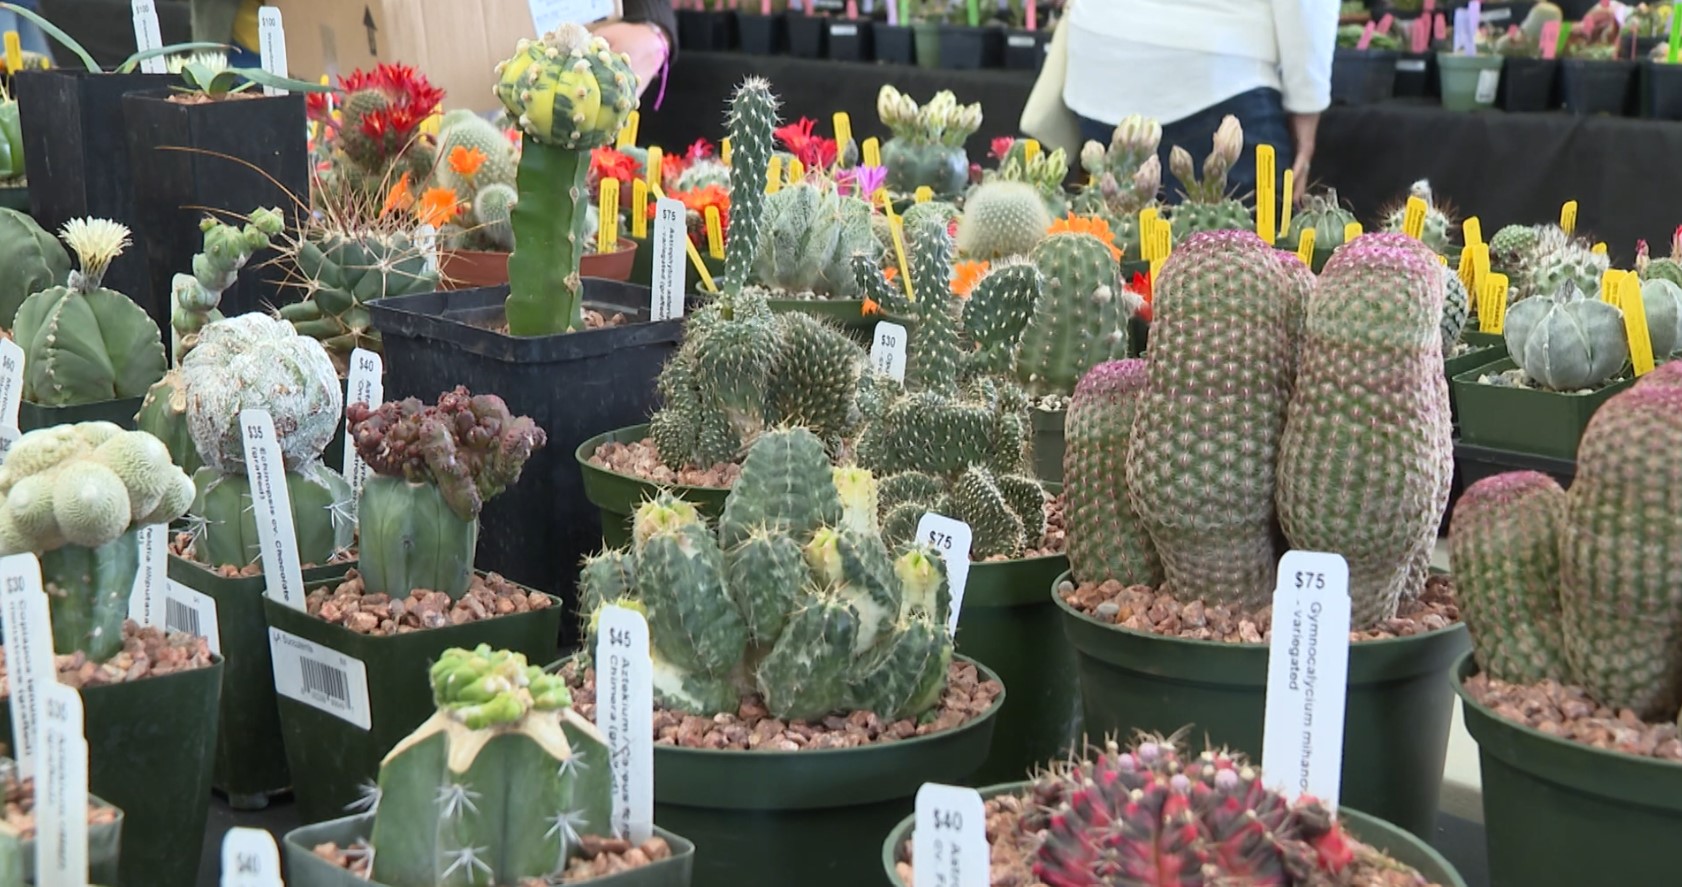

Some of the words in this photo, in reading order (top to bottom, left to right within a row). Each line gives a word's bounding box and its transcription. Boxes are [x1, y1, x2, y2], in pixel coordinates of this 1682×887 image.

[262, 18, 276, 27] $100
[662, 209, 676, 221] $75
[881, 334, 896, 348] $30
[359, 357, 374, 372] $40
[247, 425, 264, 439] $35
[251, 446, 266, 500] (grafted)
[259, 447, 276, 516] Echinopsis
[271, 518, 279, 538] cv.
[275, 540, 290, 602] Chocolate
[929, 530, 952, 550] $75
[6, 576, 25, 595] $30
[1294, 571, 1326, 590] $75
[609, 627, 631, 648] $45
[1288, 609, 1303, 690] variegated
[1302, 601, 1323, 727] Gymnocalycium
[609, 655, 618, 721] Chimera
[621, 657, 631, 732] Aztekium
[1298, 730, 1314, 794] mihano
[934, 807, 963, 831] $40
